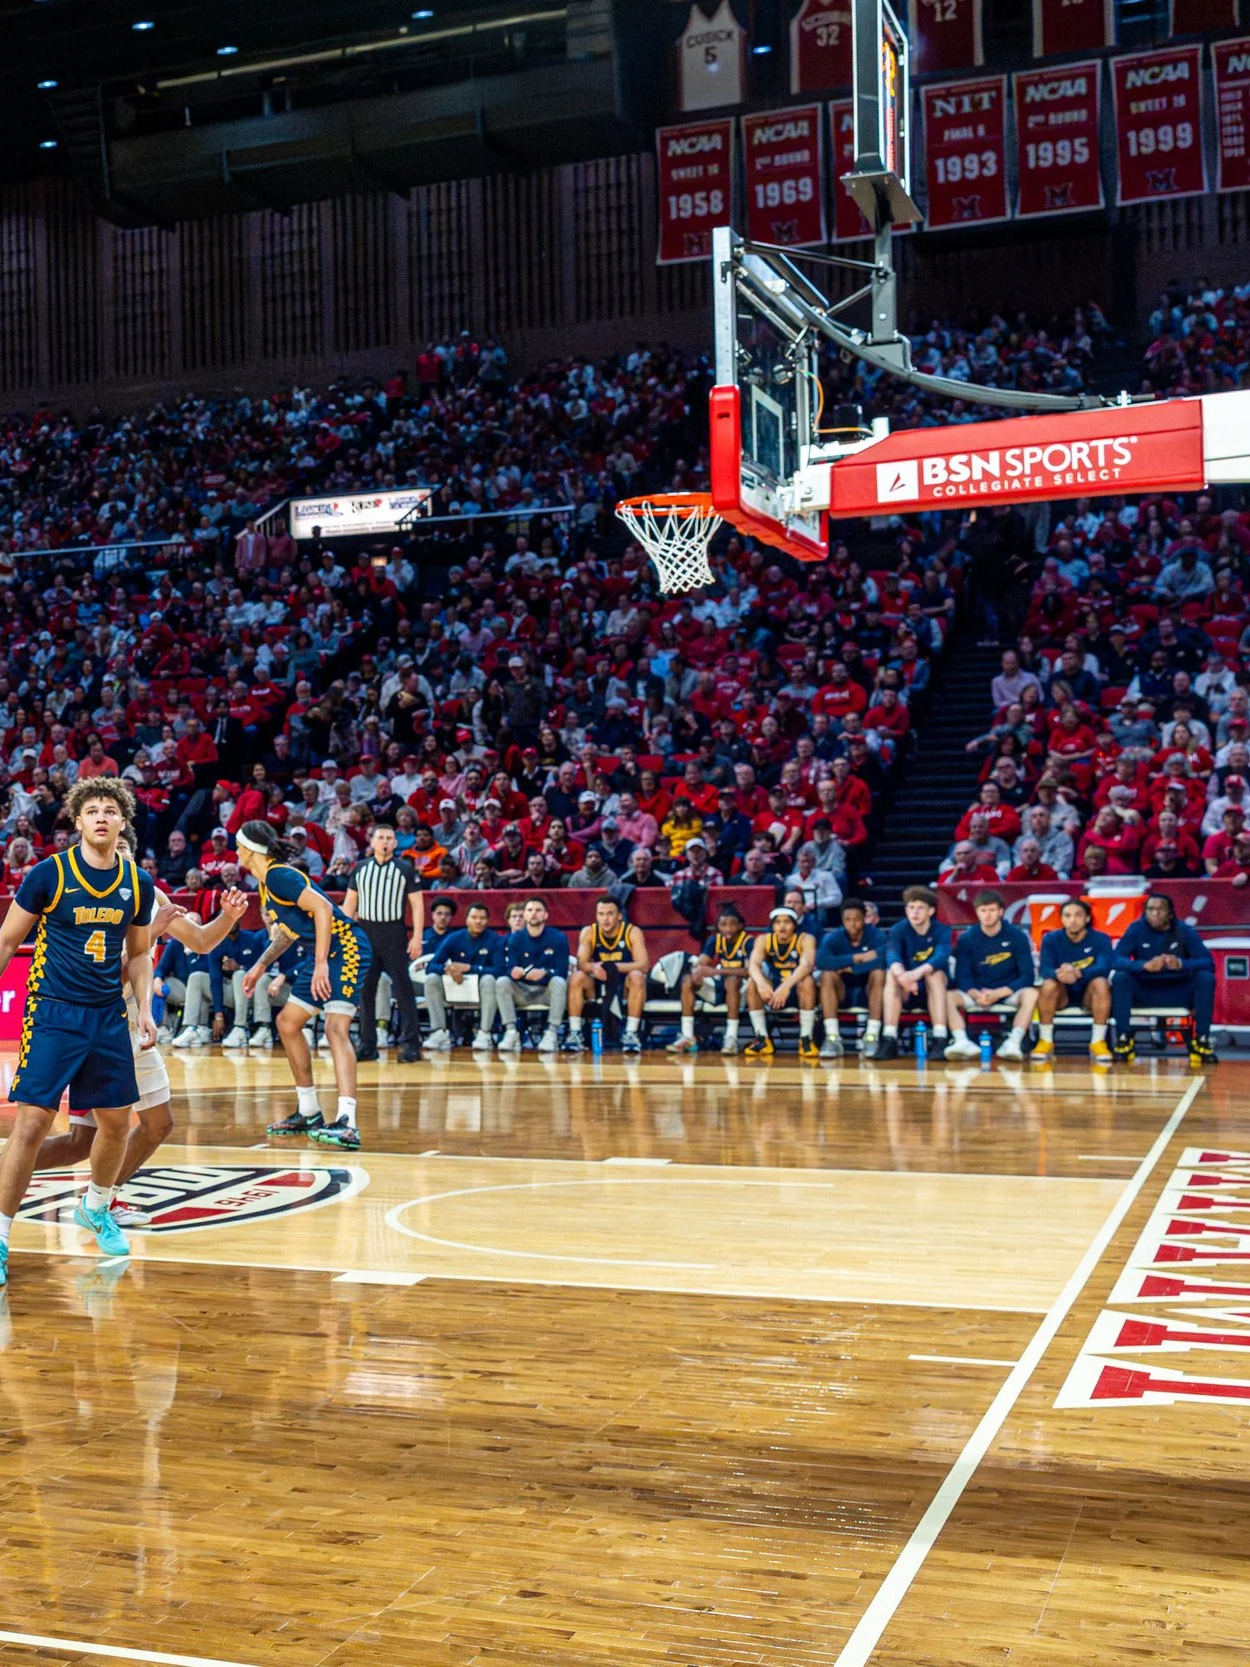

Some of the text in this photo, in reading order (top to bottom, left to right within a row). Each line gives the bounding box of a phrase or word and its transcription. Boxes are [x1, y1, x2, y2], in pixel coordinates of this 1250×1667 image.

[816, 25, 839, 47] 32
[705, 46, 717, 64] 5
[1125, 61, 1190, 89] NCAA
[933, 90, 997, 118] NIT
[1025, 77, 1087, 103] NCAA
[667, 133, 723, 157] NCAA
[753, 119, 809, 145] NCAA
[1126, 122, 1193, 157] 1999
[1026, 136, 1090, 169] 1995
[934, 150, 998, 184] 1993
[668, 189, 724, 220] 1958
[755, 176, 814, 209] 1969
[923, 450, 1001, 486] BSN
[932, 468, 1122, 498] COLLEGIATE SELECT
[73, 905, 124, 925] TOLEDO
[83, 930, 106, 963] 4
[212, 1188, 281, 1207] 1946
